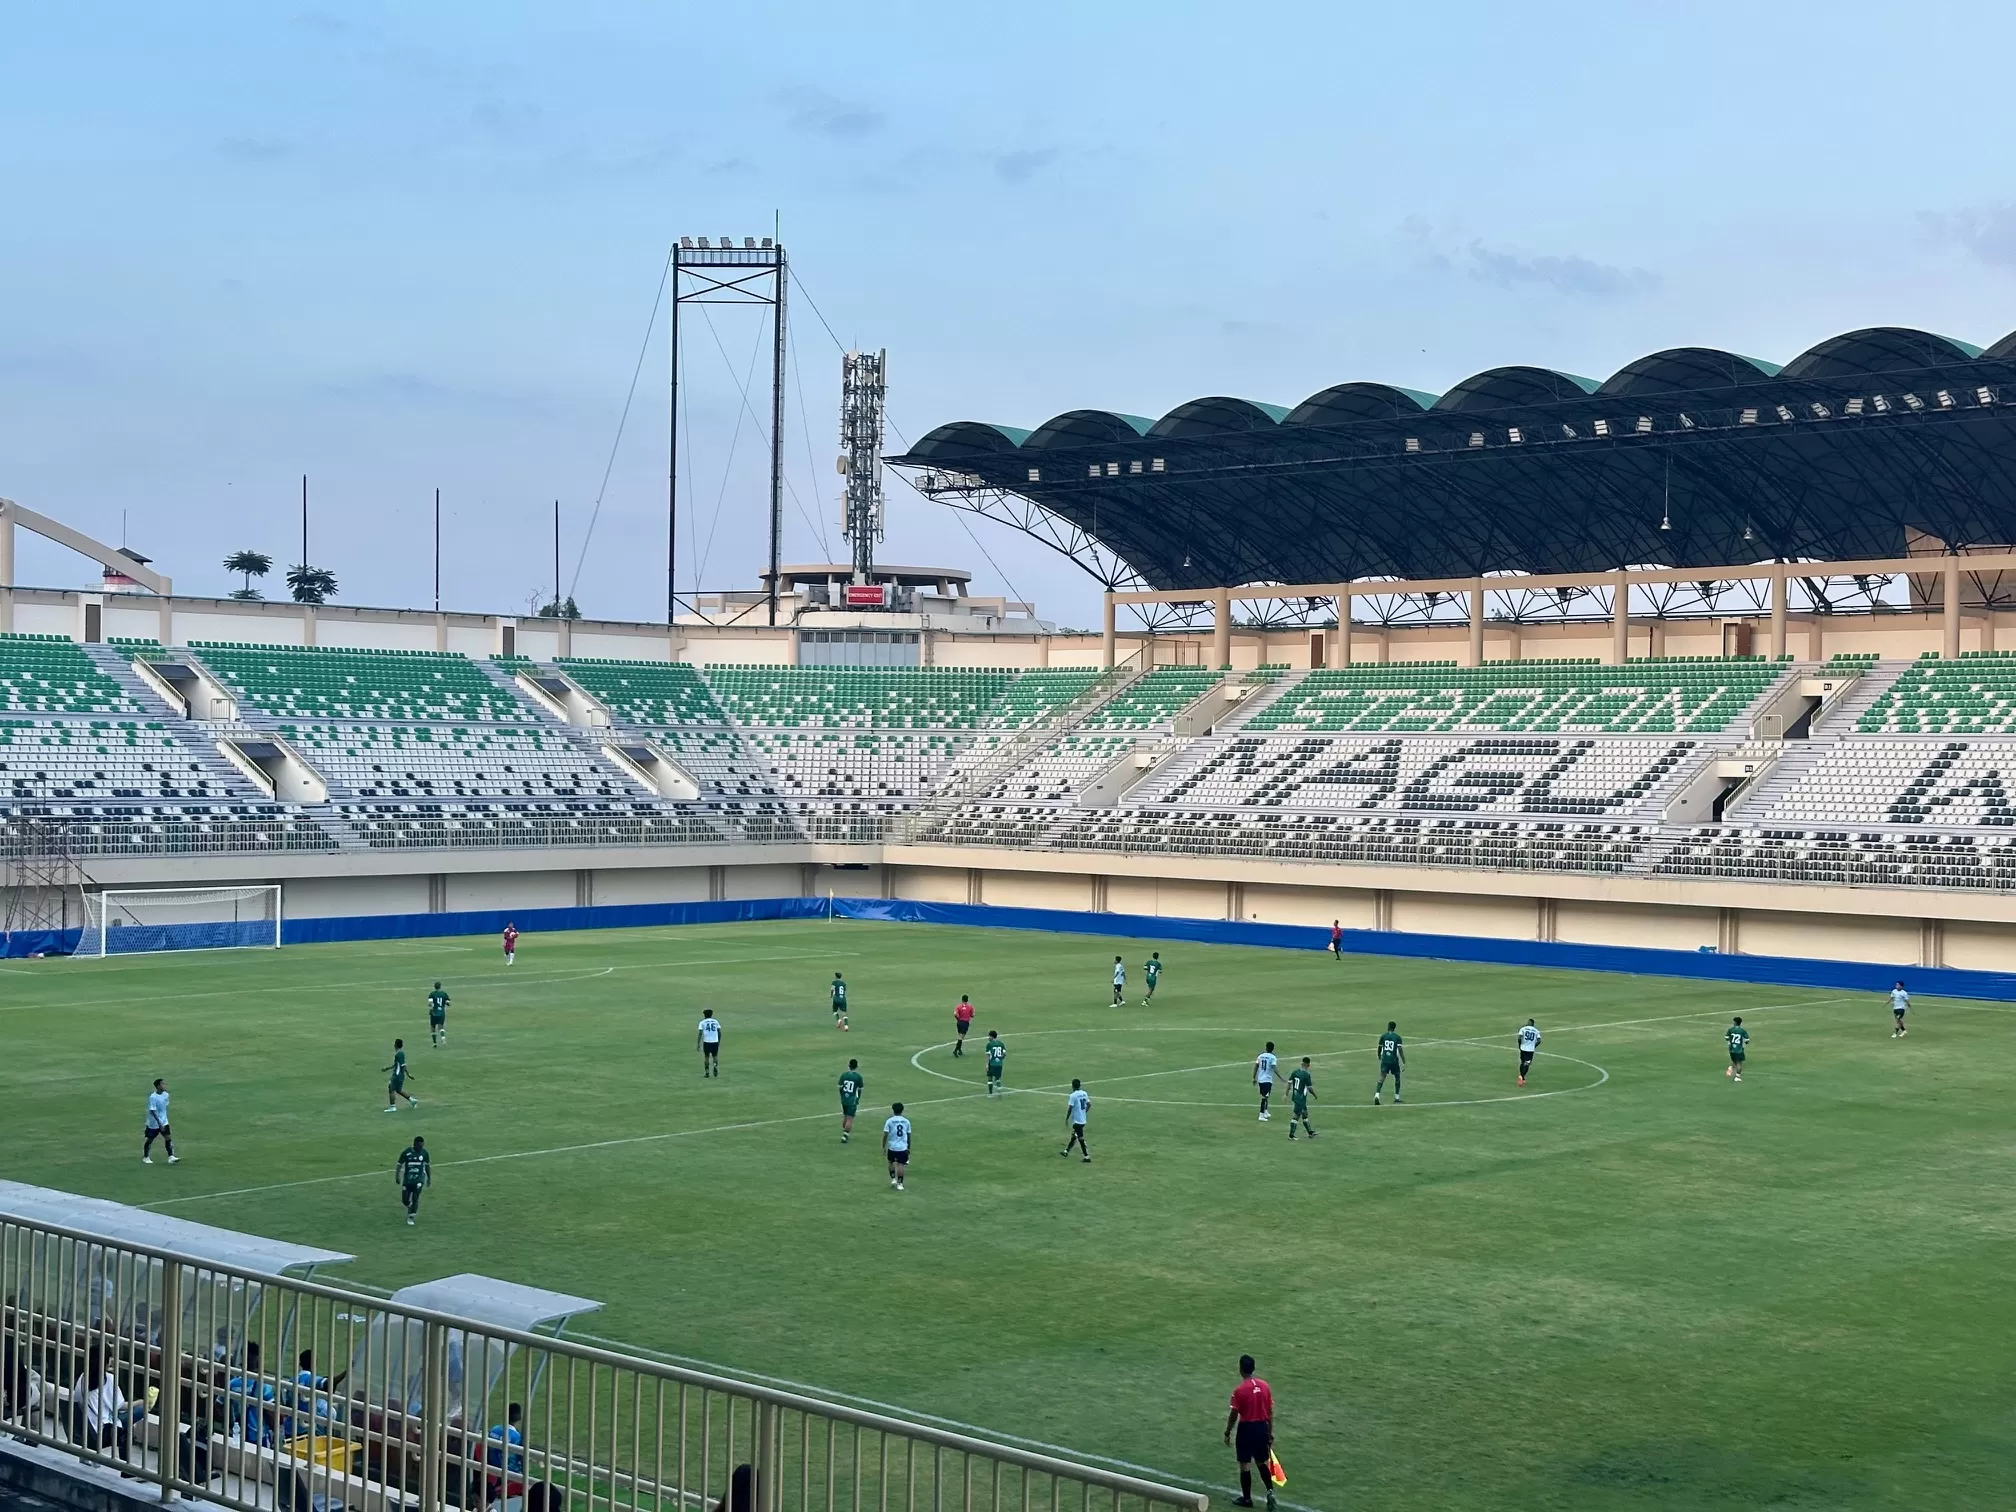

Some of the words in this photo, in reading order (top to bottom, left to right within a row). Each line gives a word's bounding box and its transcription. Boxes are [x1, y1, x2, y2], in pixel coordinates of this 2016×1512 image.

[437, 998, 442, 1006] 4
[706, 1023, 716, 1032] 46
[1731, 1033, 1741, 1044] 72
[1384, 1040, 1394, 1051] 93
[843, 1081, 854, 1092] 30
[896, 1125, 903, 1137] 8
